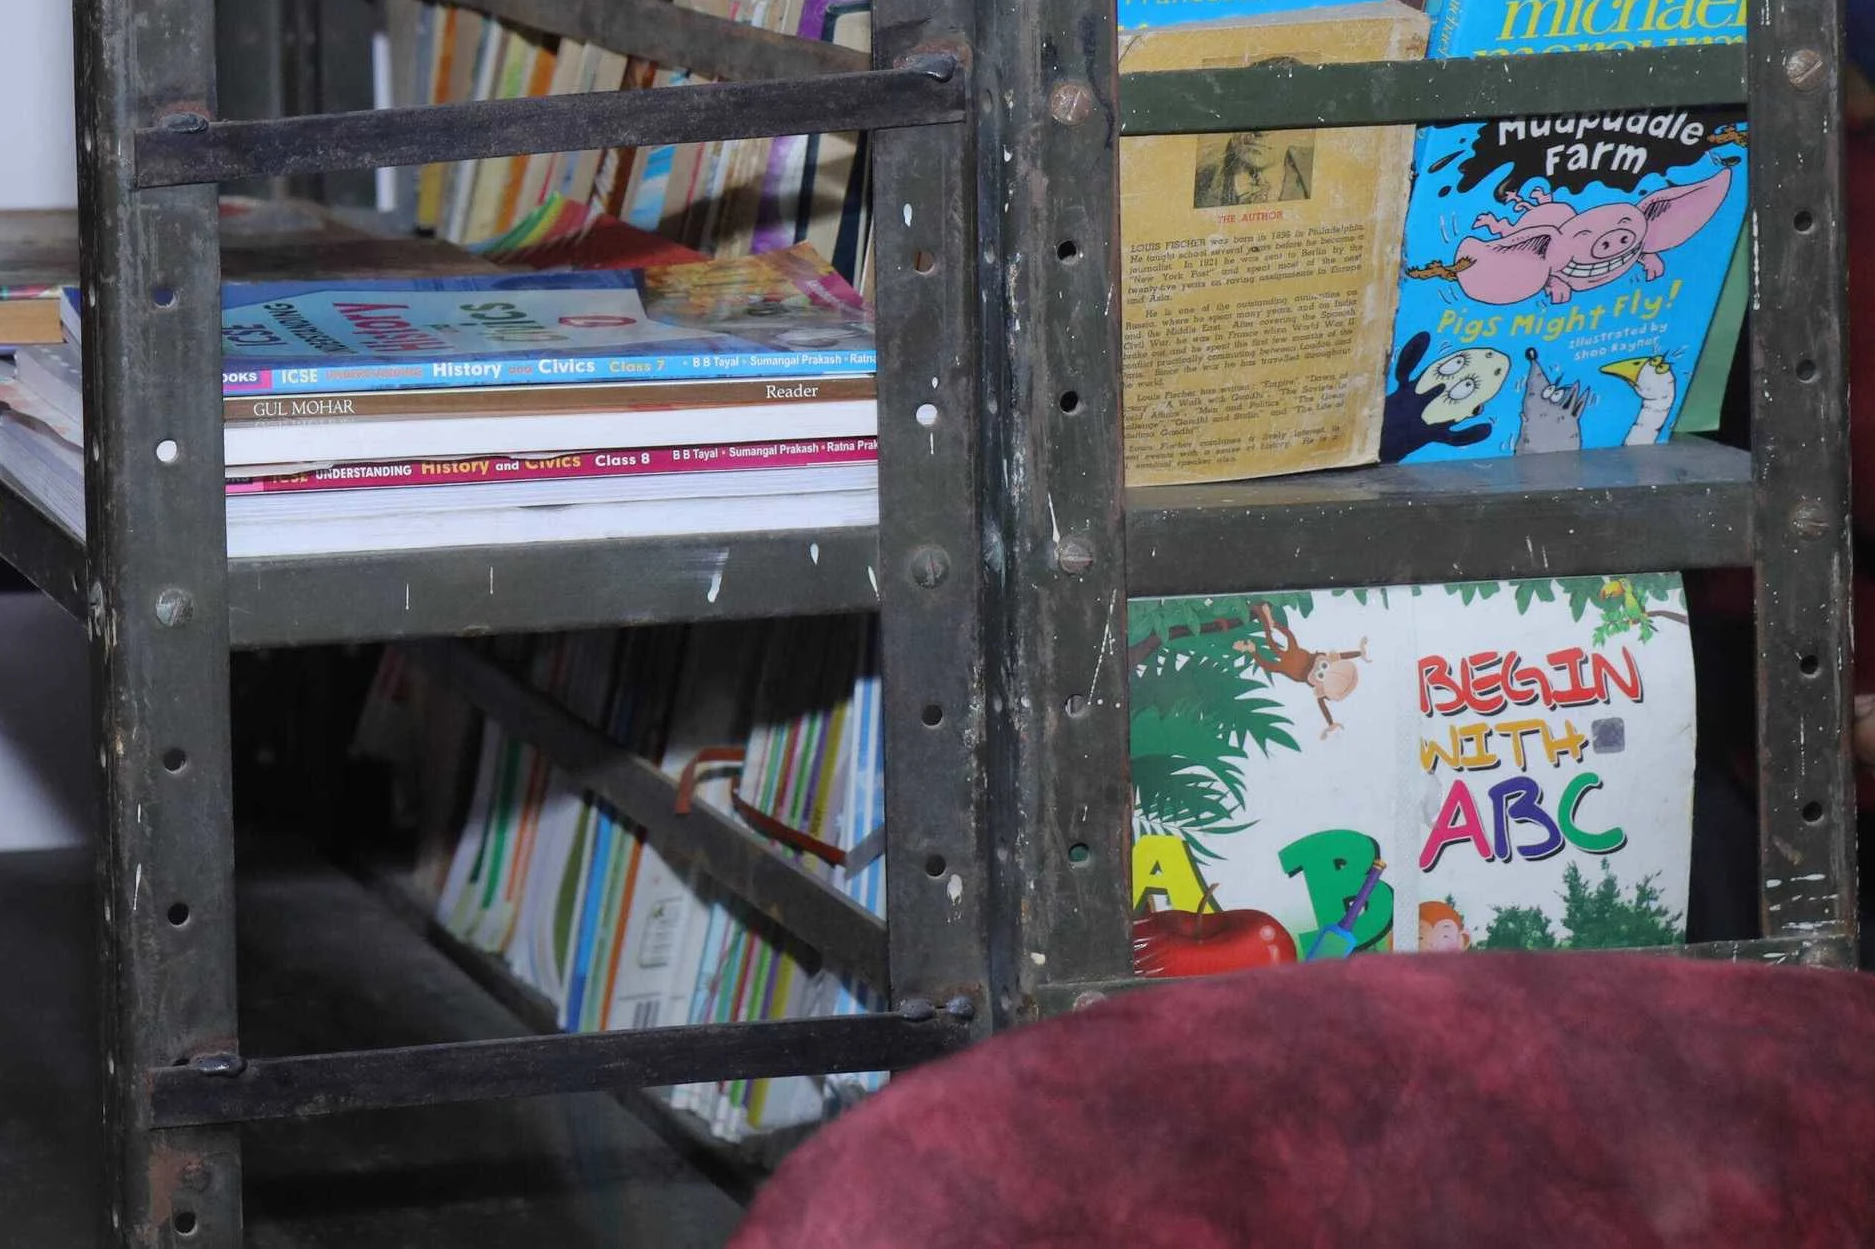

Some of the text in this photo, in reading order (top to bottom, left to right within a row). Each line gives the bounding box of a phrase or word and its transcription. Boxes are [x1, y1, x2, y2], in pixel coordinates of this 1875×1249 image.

[1546, 140, 1648, 176] Farm
[1218, 211, 1283, 223] THE AUTHOR
[1131, 242, 1161, 253] LOUIS
[1165, 238, 1205, 250] FISCHER
[1436, 279, 1684, 344] Pigs Might Fly!
[1651, 322, 1669, 335] by
[282, 369, 317, 384] ICSE
[433, 362, 501, 380] History
[539, 358, 595, 374] Civics
[609, 361, 651, 372] Class
[657, 360, 665, 371] 7
[693, 358, 700, 368] B
[703, 357, 711, 367] B
[713, 356, 739, 370] Tayal
[749, 354, 799, 370] Sumangal
[801, 354, 841, 366] Prakash
[253, 384, 819, 417] GUL MOHAR Reader
[316, 464, 412, 480] UNDERSTANDING
[495, 460, 519, 472] and
[595, 454, 637, 467] Class
[641, 452, 651, 464] 8
[673, 450, 680, 460] B
[683, 449, 690, 459] B
[693, 448, 718, 461] Tayal
[729, 446, 777, 461] Sumangal
[779, 443, 819, 455] Prakash
[827, 440, 855, 452] Ratna
[1417, 646, 1645, 717] BEGIN
[1419, 716, 1589, 773] WITH
[1418, 771, 1629, 873] ABC
[1131, 834, 1222, 914] A
